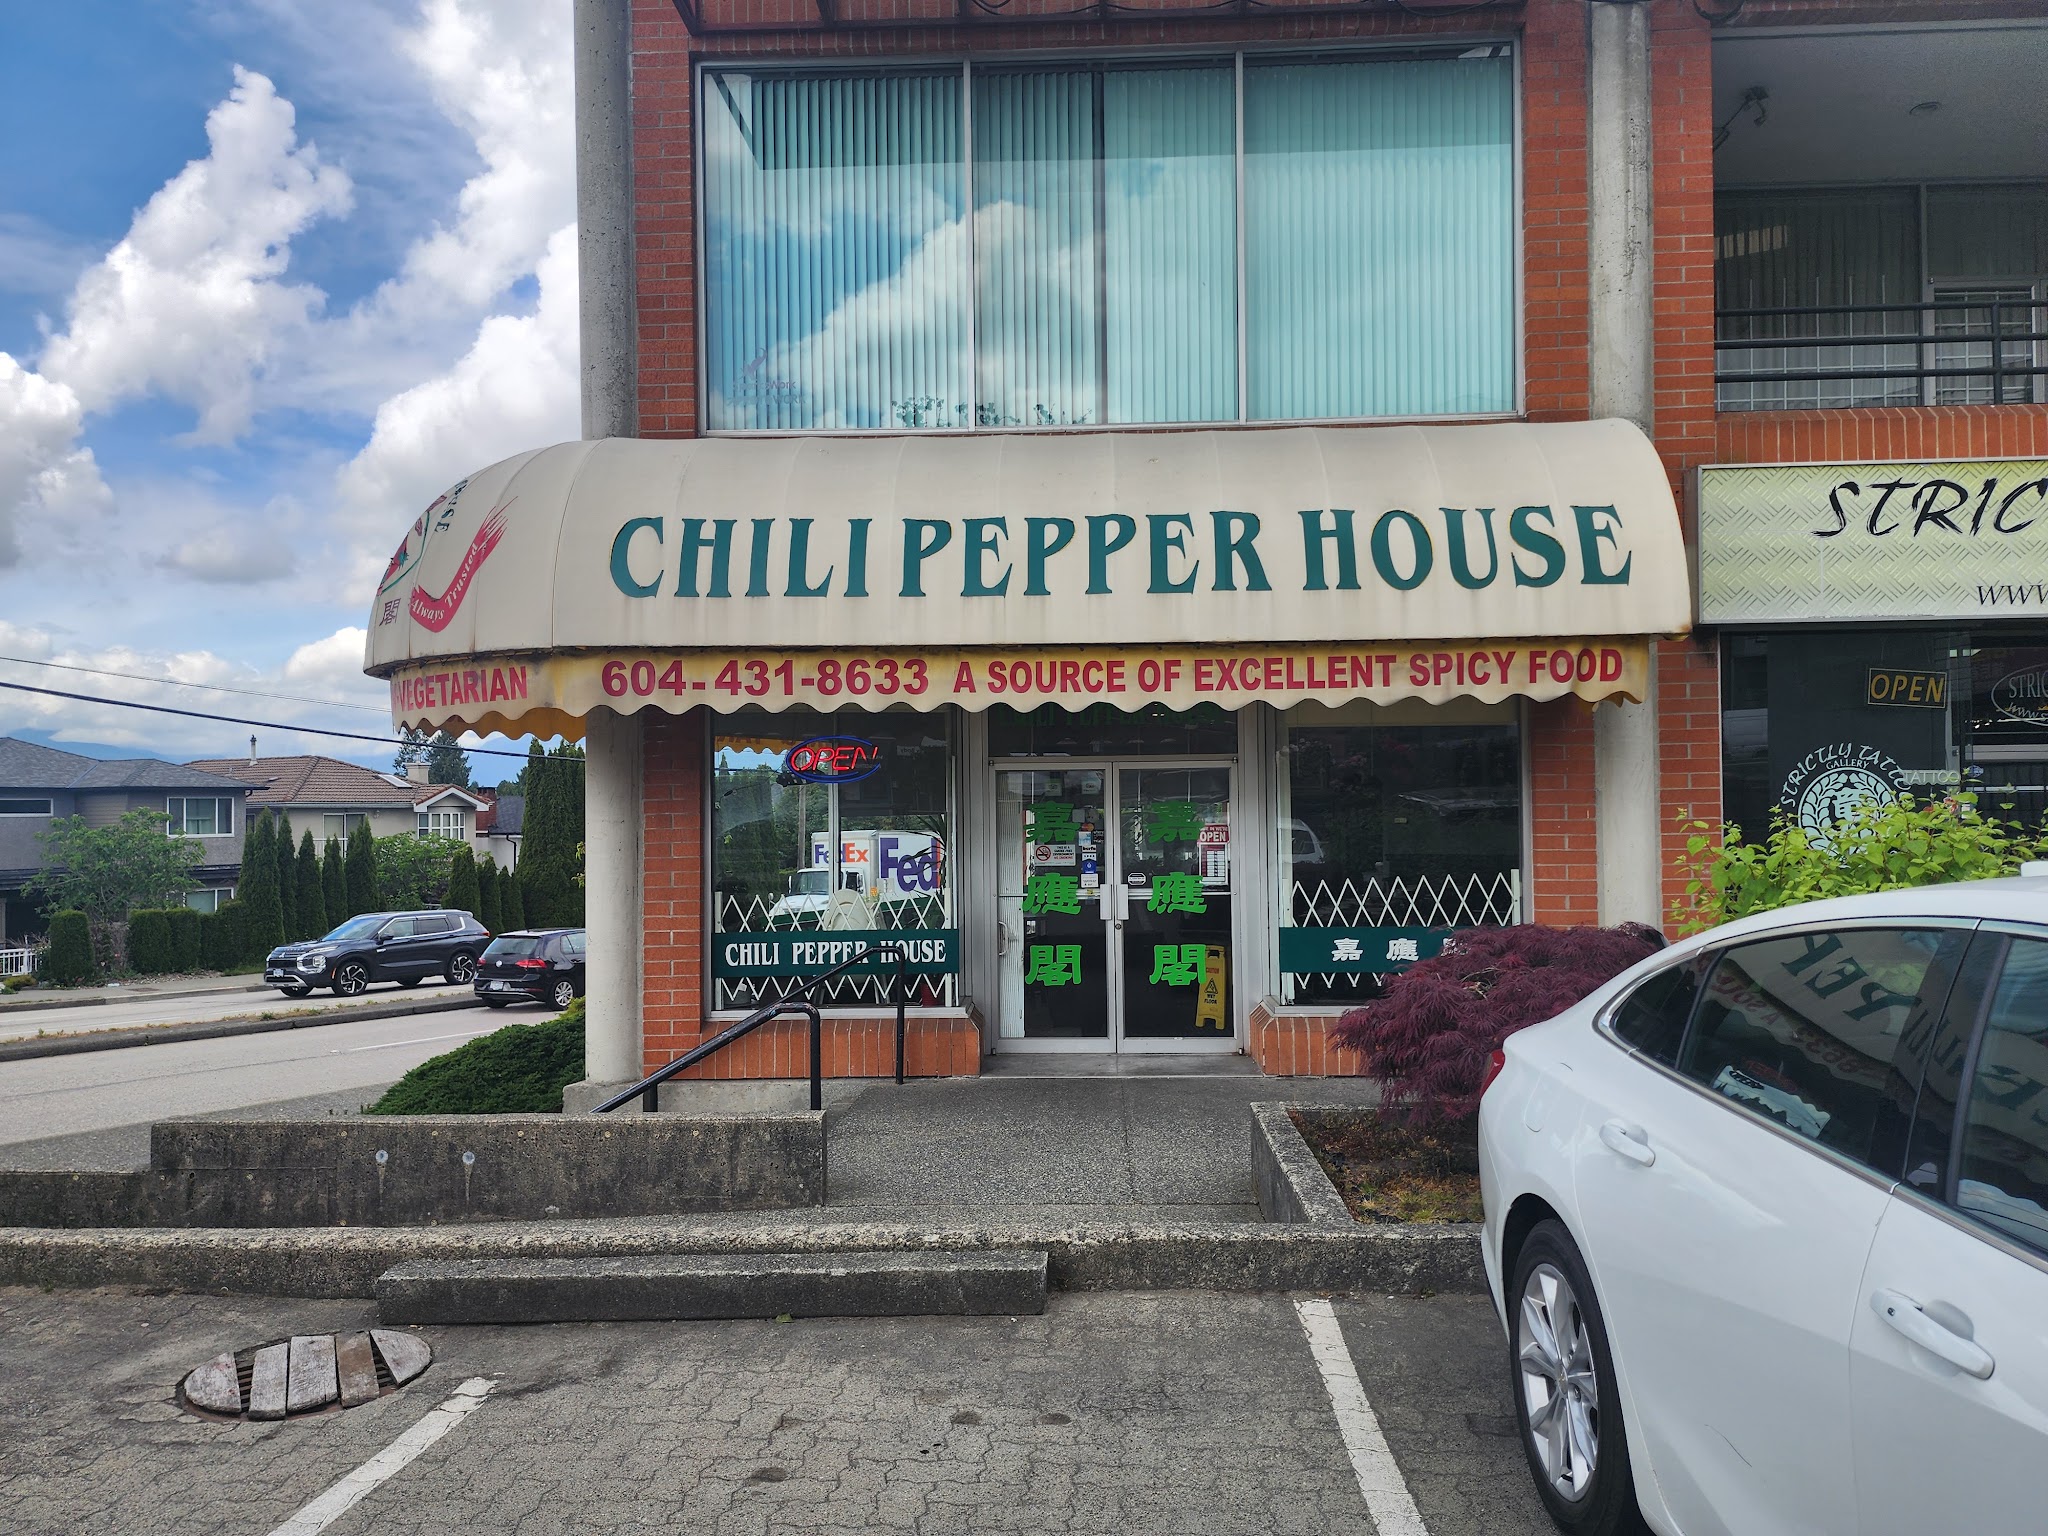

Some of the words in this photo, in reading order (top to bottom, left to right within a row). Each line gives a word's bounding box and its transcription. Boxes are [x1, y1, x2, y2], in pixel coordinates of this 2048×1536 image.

[1811, 478, 2048, 537] STRIC
[609, 516, 873, 598] CHILI
[898, 511, 1272, 598] PEPPER
[1298, 505, 1632, 591] HOUSE
[410, 598, 445, 624] Always
[444, 542, 478, 609] Trusted
[601, 658, 930, 697] 604-431-8633
[953, 661, 977, 694] A
[987, 660, 1126, 694] SOURCE
[1137, 659, 1182, 693] OF
[1194, 654, 1397, 692] EXCELLENT
[1408, 650, 1517, 687] SPICY
[1528, 647, 1623, 685] FOOD
[1870, 674, 1945, 703] OPEN
[790, 746, 878, 771] OPEN
[1780, 742, 1852, 808] STRICTLY
[1859, 744, 1915, 803] TATTO
[1826, 758, 1870, 770] GALLERY
[1902, 769, 1963, 787] TATTOO
[1199, 831, 1226, 842] OPEN
[879, 836, 941, 893] Fed
[725, 942, 780, 967] CHILI
[792, 940, 869, 966] PEPPER
[880, 939, 946, 963] HOUSE
